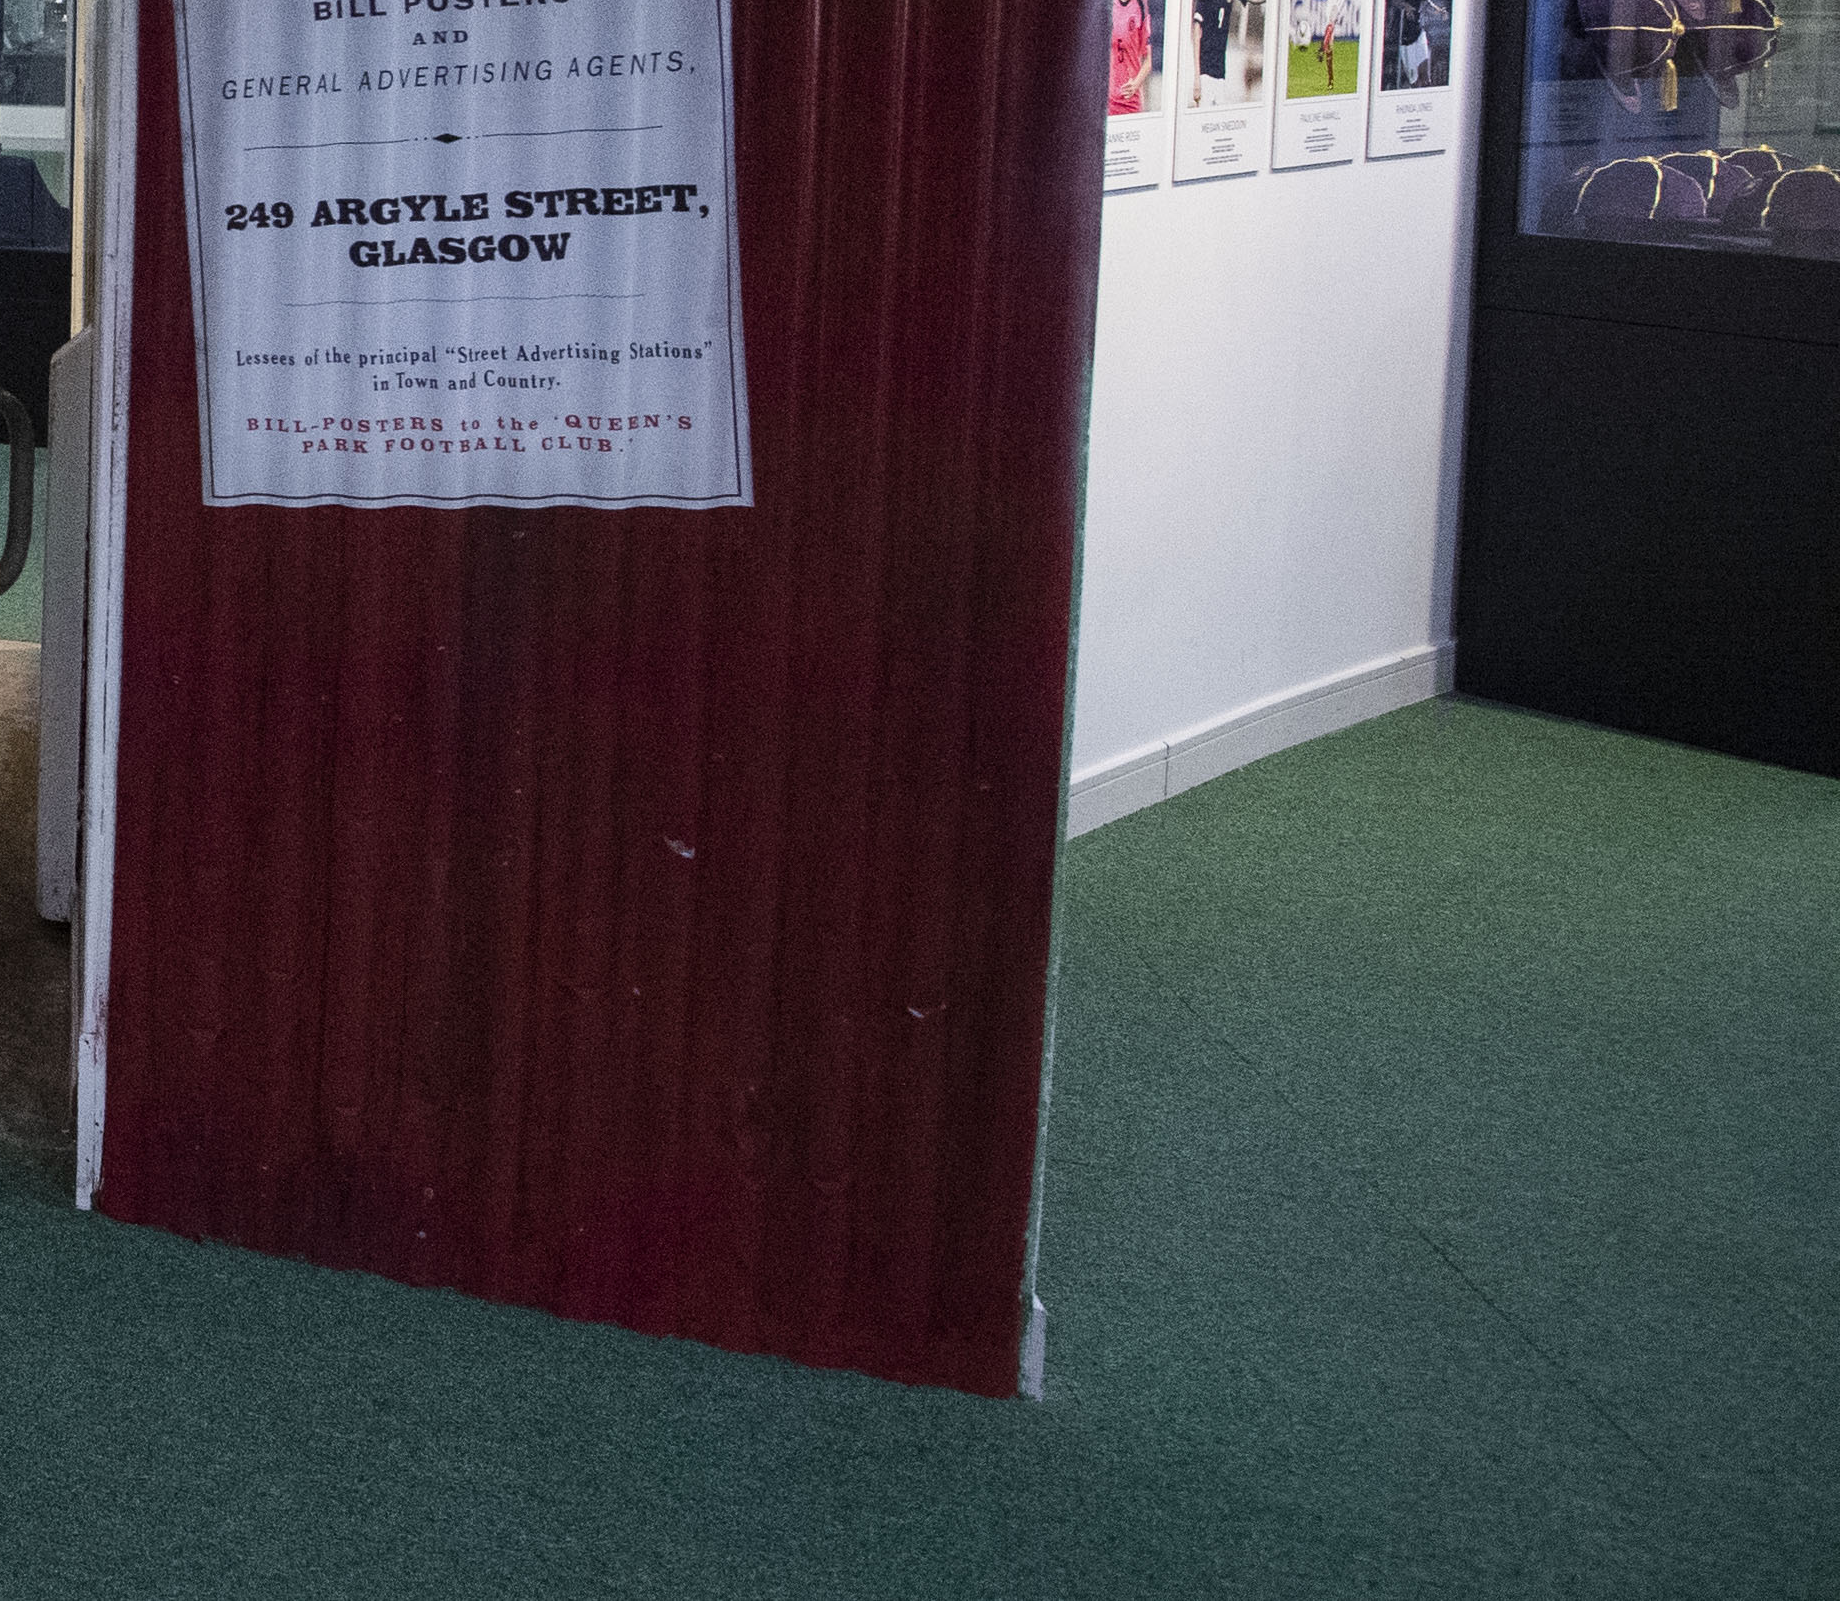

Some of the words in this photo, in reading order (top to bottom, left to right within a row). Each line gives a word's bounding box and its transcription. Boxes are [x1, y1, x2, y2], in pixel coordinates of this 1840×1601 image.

[412, 29, 469, 46] AND
[222, 73, 343, 101] GENERAL
[358, 60, 554, 93] ADVERTISING
[567, 50, 697, 79] AGENTS,
[225, 200, 295, 232] 249
[310, 192, 490, 228] ARGYLE
[504, 183, 711, 220] STREET,
[349, 232, 572, 268] GLASGOW
[235, 349, 297, 367] Lessees
[304, 348, 320, 366] of
[325, 347, 352, 366] the
[359, 346, 438, 368] principal
[515, 342, 622, 365] Advertising
[372, 375, 390, 392] in
[395, 372, 440, 391] Town
[448, 371, 477, 391] and
[483, 370, 561, 391] Country.
[246, 415, 445, 434] BILL-POSTERS
[460, 416, 481, 432] to
[496, 415, 540, 432] the
[301, 437, 370, 455] PARK
[385, 435, 527, 455] FOOTBALL
